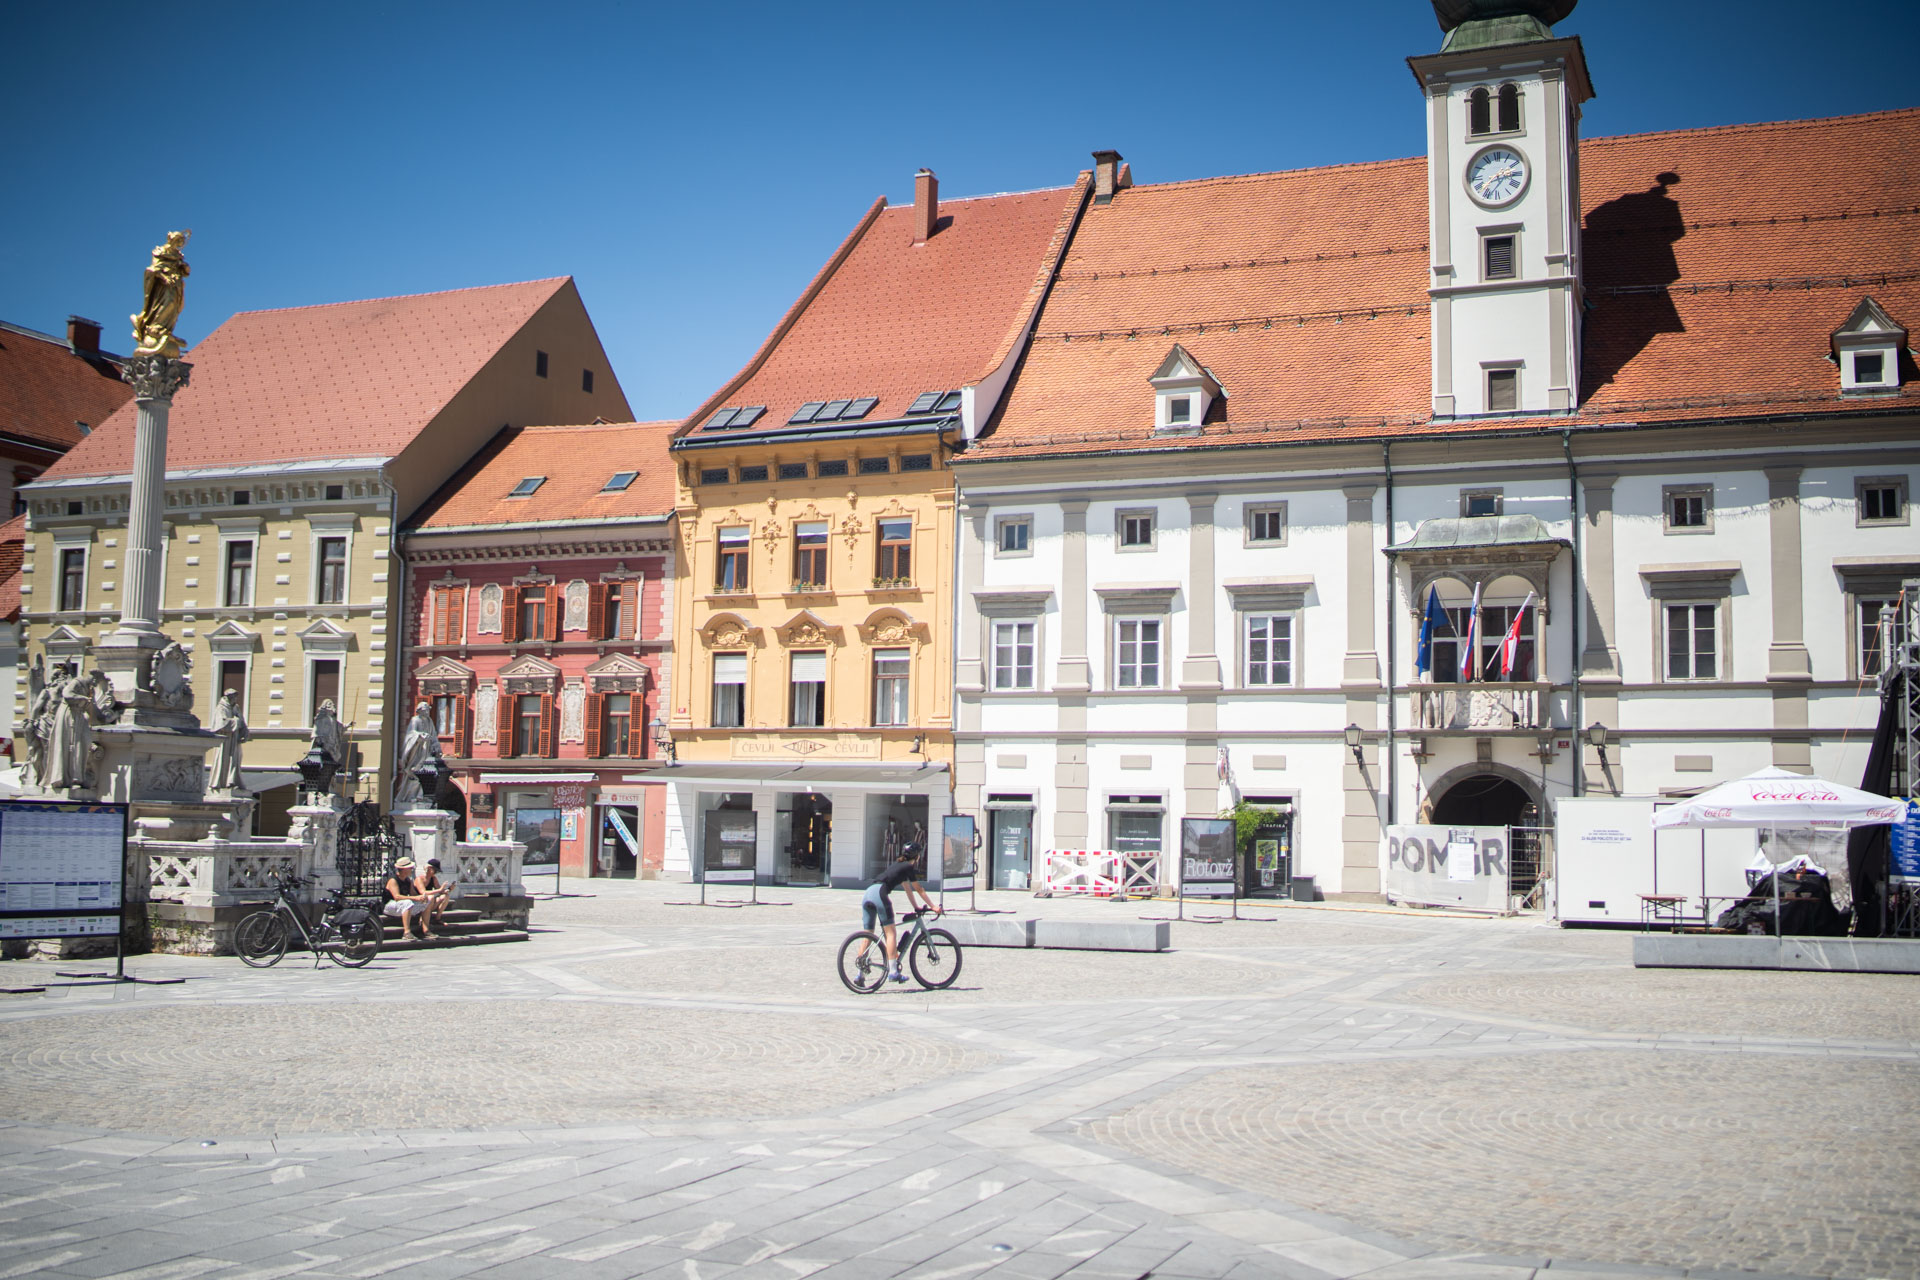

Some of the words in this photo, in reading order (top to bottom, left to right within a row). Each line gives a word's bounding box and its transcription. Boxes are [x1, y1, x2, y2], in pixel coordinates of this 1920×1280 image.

[742, 742, 775, 753] ČEVLJI
[835, 742, 868, 753] ČEVLJI
[1753, 790, 1841, 801] Coca-Cola
[1704, 807, 1732, 818] Coca-Cola
[1866, 808, 1897, 818] Coca-Cola
[1184, 857, 1234, 877] Rotovž
